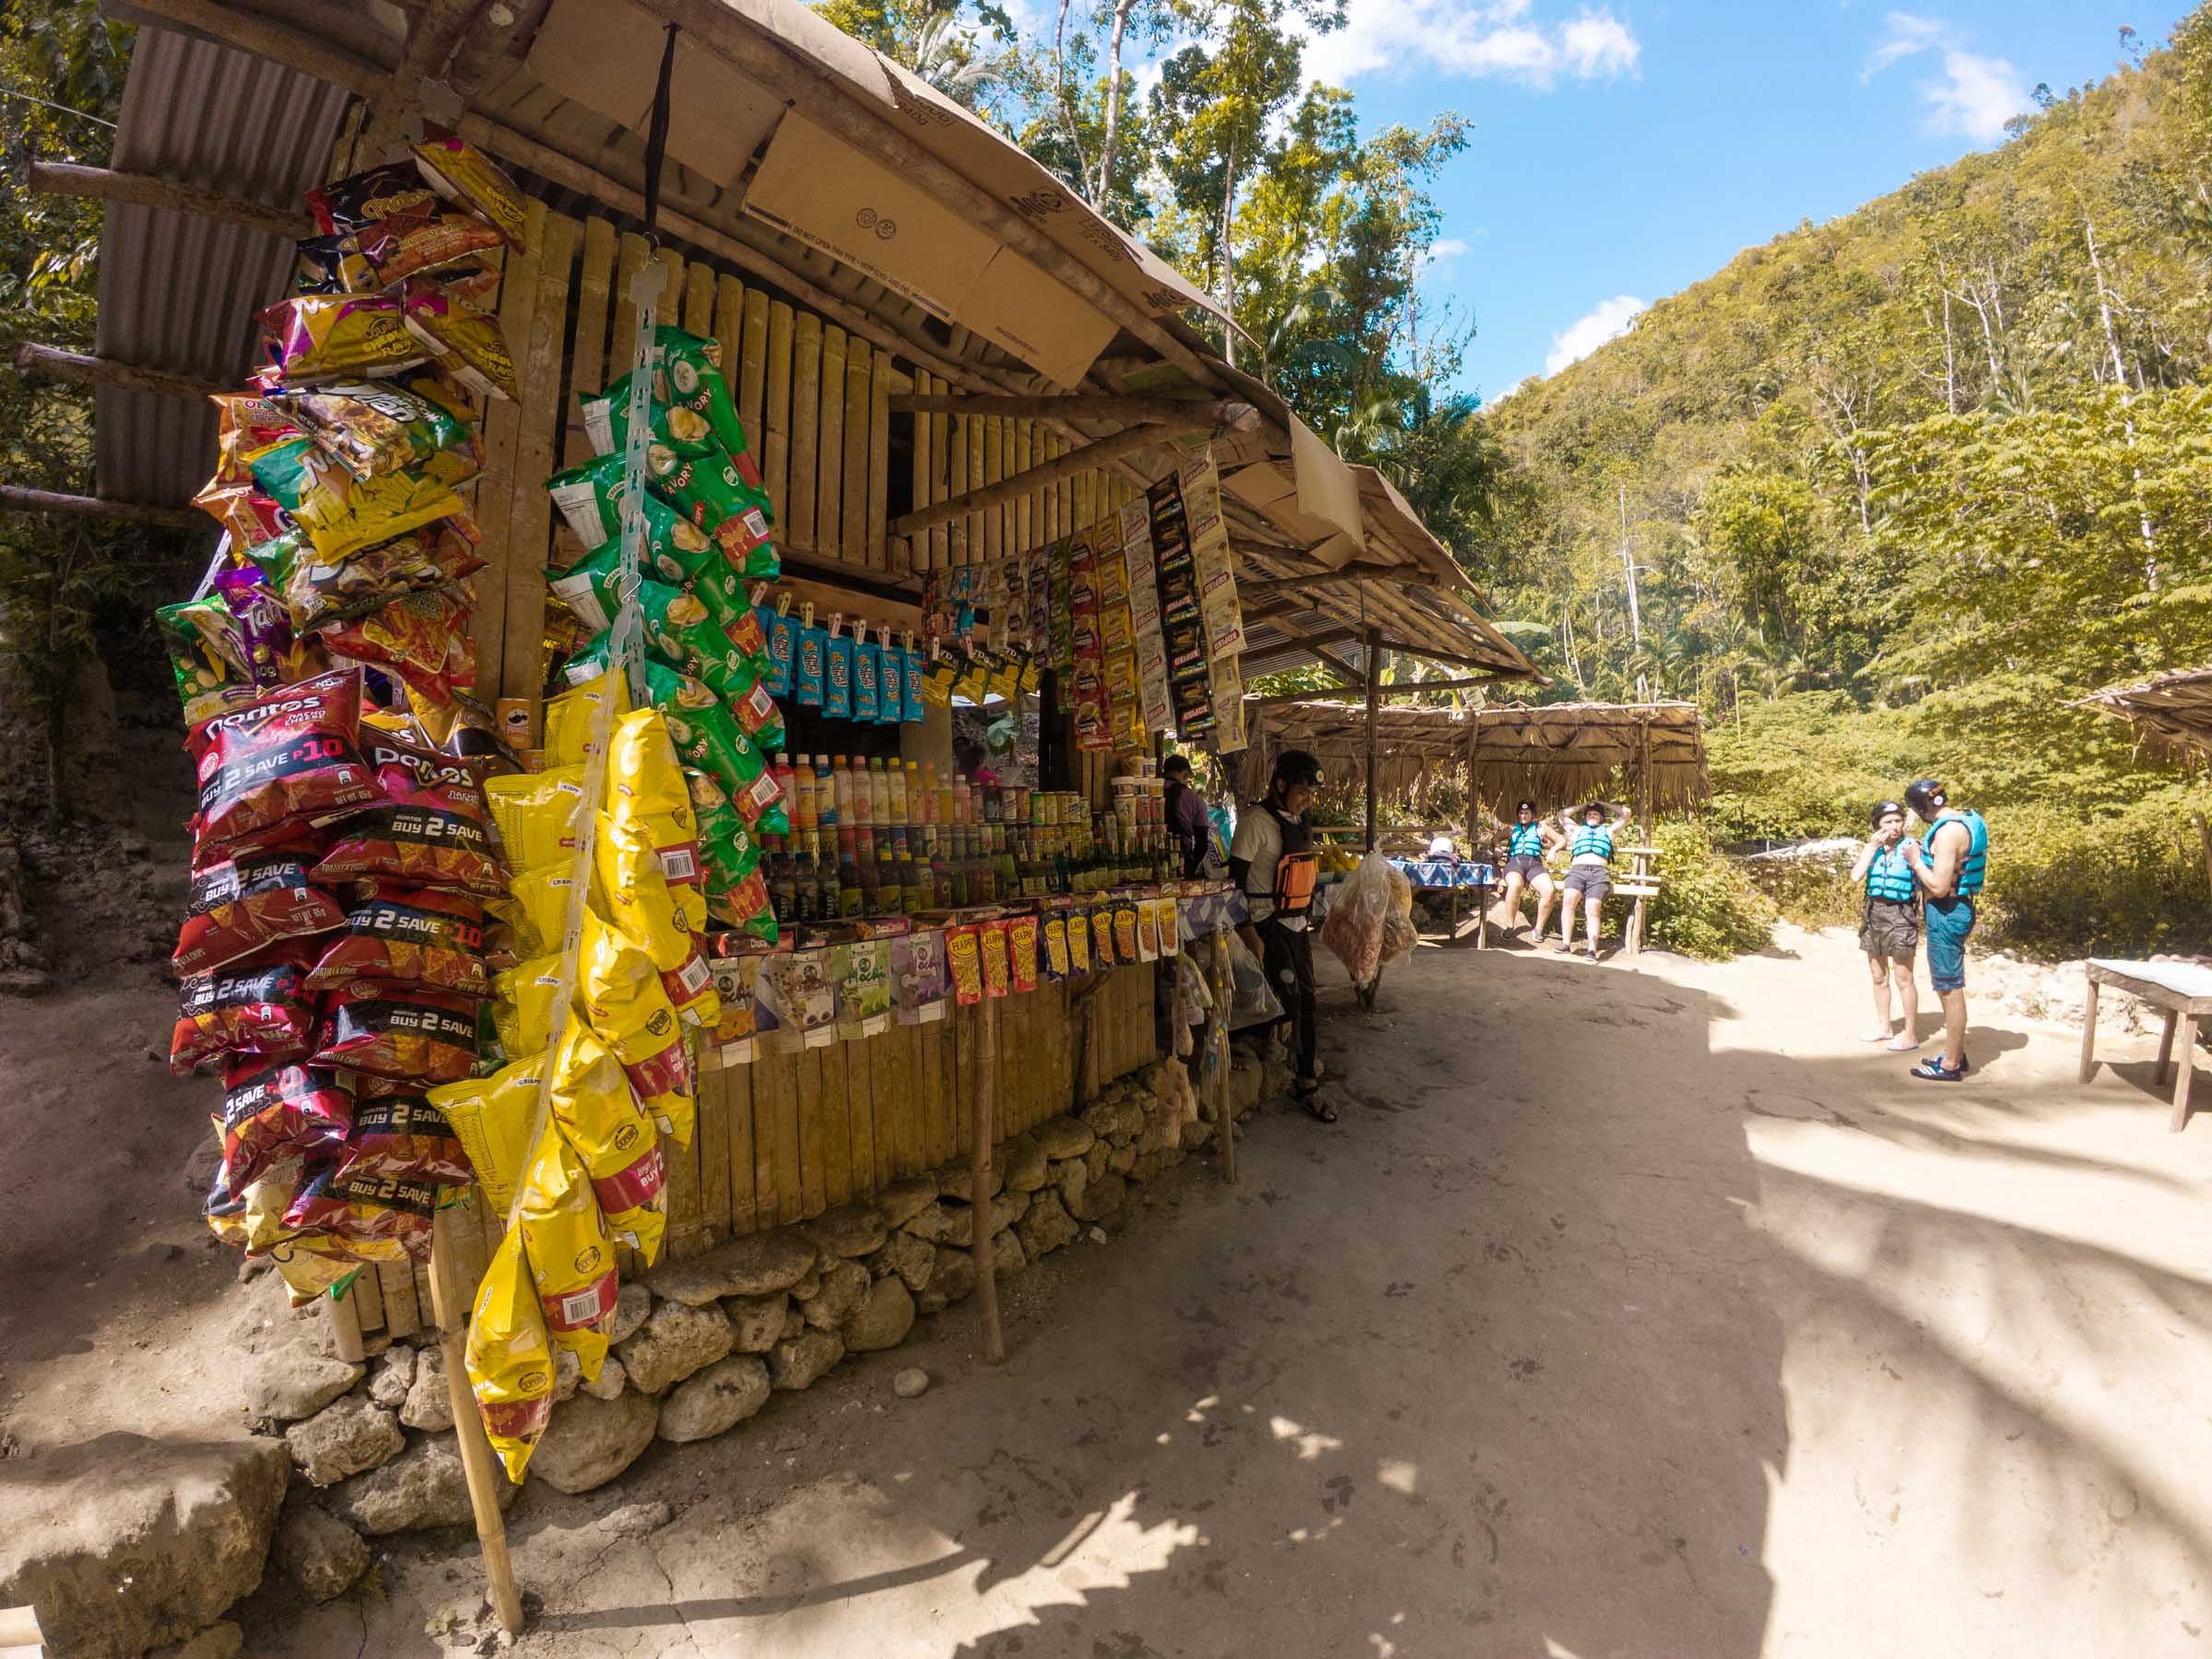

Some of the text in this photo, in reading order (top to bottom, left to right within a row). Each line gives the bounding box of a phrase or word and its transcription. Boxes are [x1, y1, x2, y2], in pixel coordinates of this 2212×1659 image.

[206, 696, 322, 742] Doritos
[244, 752, 288, 776] SAVE
[391, 817, 484, 842] BUY 2 SAVE
[205, 885, 230, 902] BUY
[252, 863, 296, 882] SAVE
[373, 909, 396, 929] 2
[396, 915, 441, 935] SAVE
[194, 991, 215, 1006] BUY
[217, 979, 235, 1000] 2
[234, 976, 275, 994] SAVE
[390, 1012, 473, 1039] BUY 2 SAVE
[235, 1084, 265, 1112] SAVE
[359, 1112, 389, 1126] BUY
[391, 1104, 409, 1124] 2
[349, 1179, 431, 1205] BUY 2 SAVE
